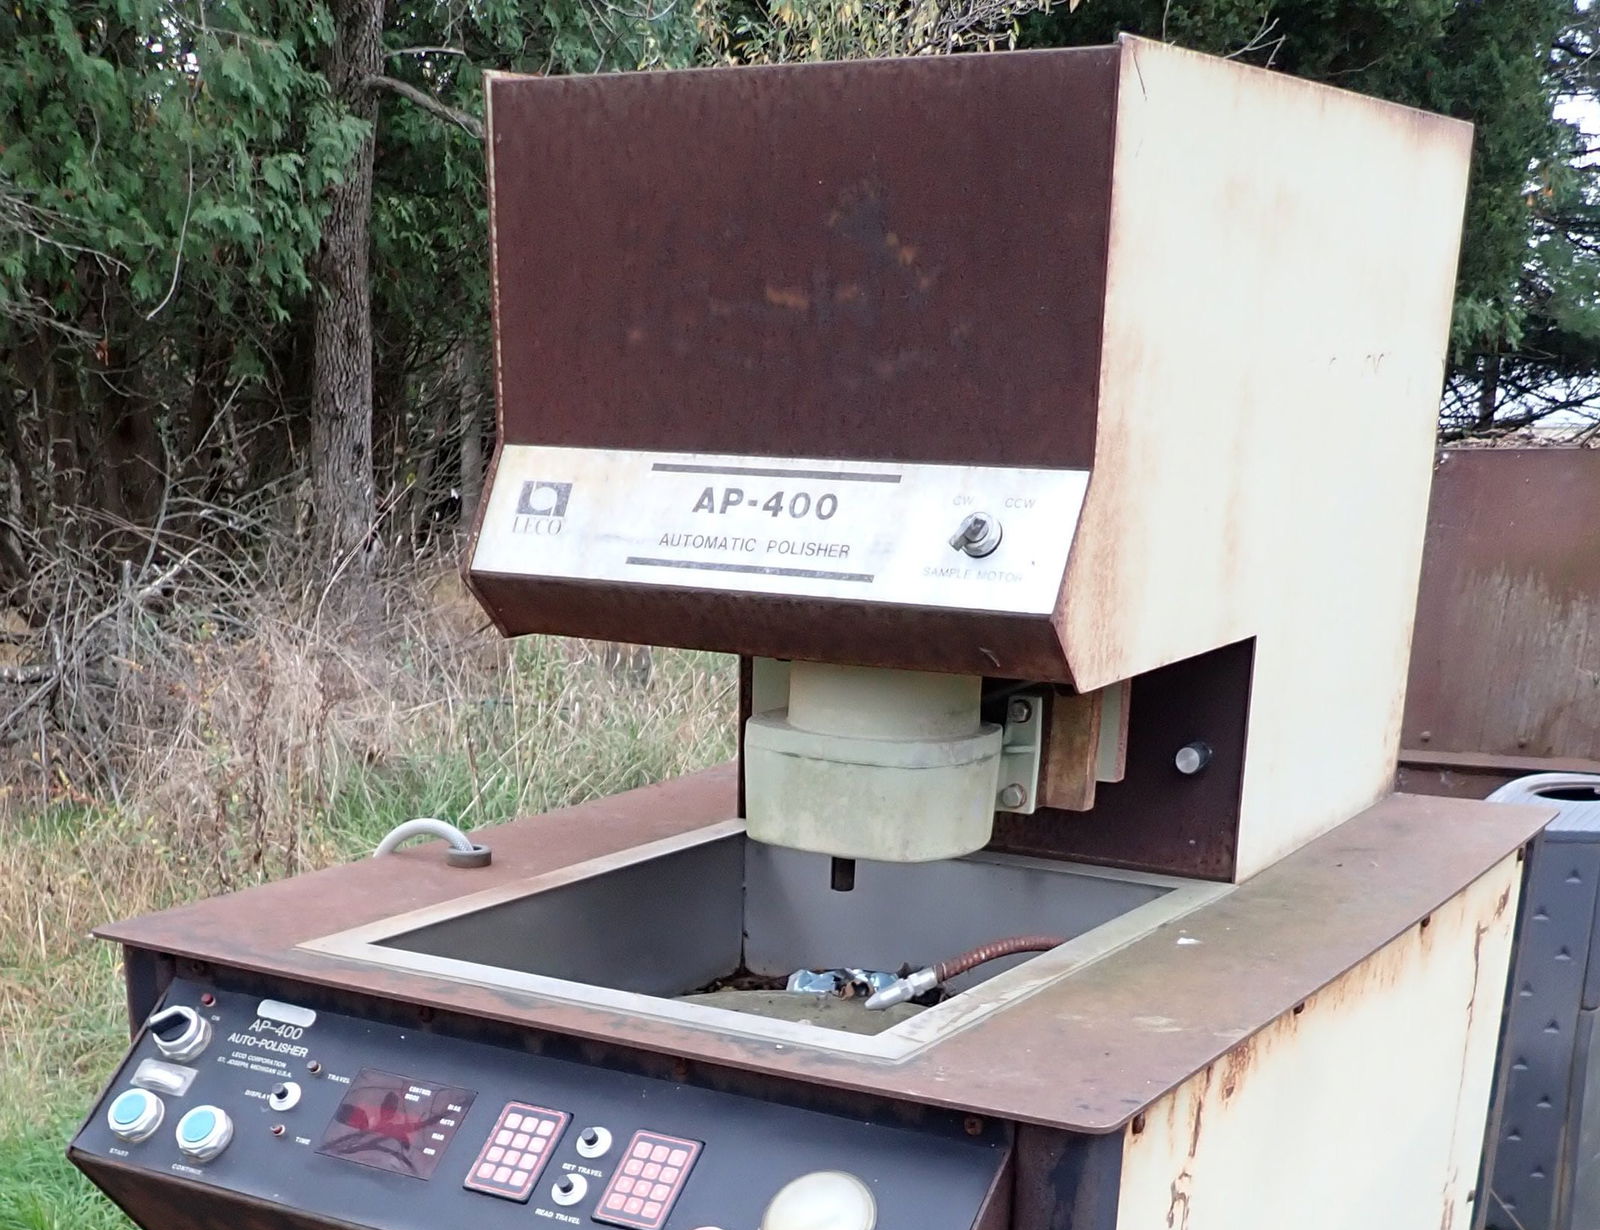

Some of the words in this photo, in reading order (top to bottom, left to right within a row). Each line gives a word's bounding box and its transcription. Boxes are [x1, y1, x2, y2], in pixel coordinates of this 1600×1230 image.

[692, 486, 838, 520] AP-400
[1004, 497, 1036, 509] CCW
[659, 532, 757, 552] AUTOMATIC
[766, 538, 850, 558] POLISHER
[922, 566, 972, 580] SAMPLE
[248, 1018, 304, 1040] AP-400
[227, 1032, 308, 1058] AUTO-POLISHER
[247, 1054, 287, 1068] CORPORATION
[578, 1166, 602, 1178] TRAVEL
[534, 1208, 554, 1218] READ
[555, 1212, 580, 1225] TRAVEL
